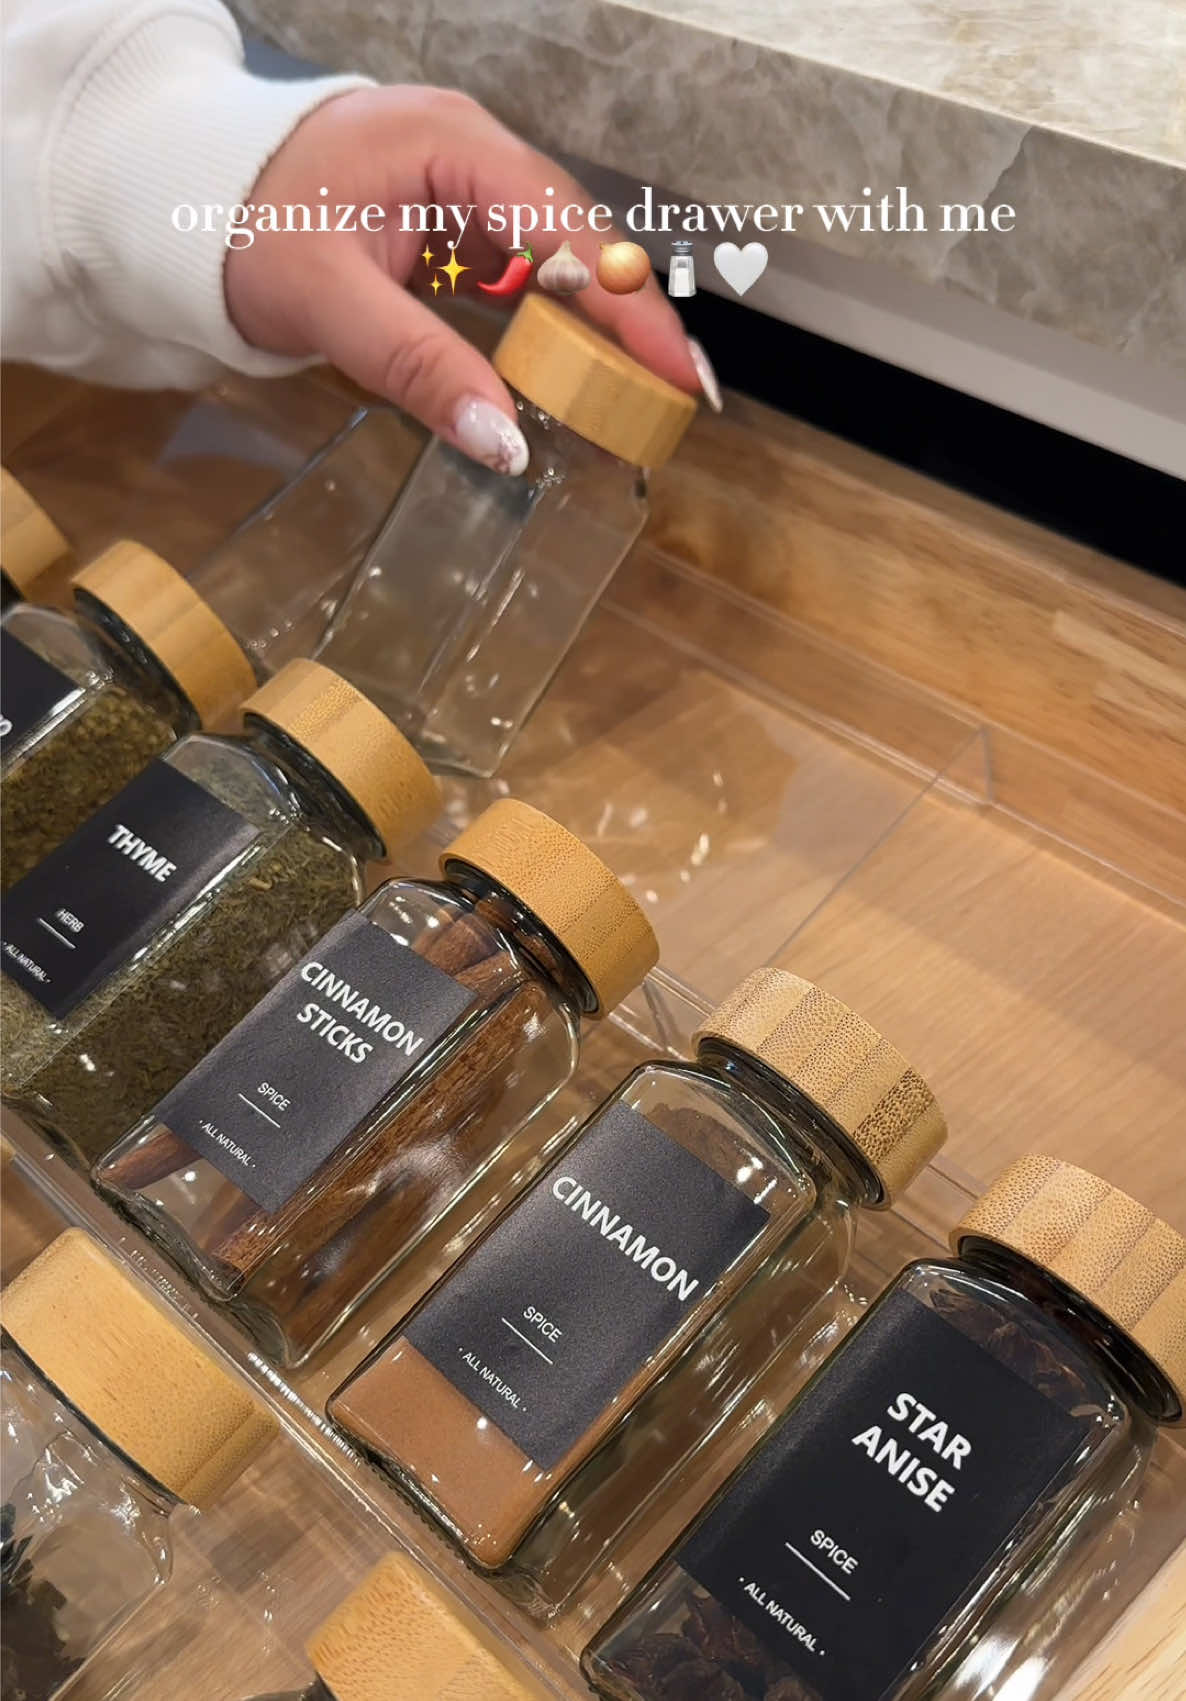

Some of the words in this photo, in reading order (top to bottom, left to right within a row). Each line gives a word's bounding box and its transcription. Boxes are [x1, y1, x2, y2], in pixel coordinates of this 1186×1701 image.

[107, 823, 177, 882] THYME
[56, 908, 85, 933] HERB
[5, 944, 20, 958] ALL
[17, 953, 48, 982] NATURAL
[296, 1003, 374, 1063] STICKS
[301, 961, 424, 1057] CINNAMON
[257, 1082, 291, 1111] SPICE
[202, 1122, 218, 1138] ALL
[216, 1133, 251, 1166] NATURAL
[552, 1176, 699, 1302] CINNAMON
[523, 1306, 562, 1343] SPICE
[462, 1352, 481, 1371] ALL
[479, 1366, 521, 1408] NATURAL
[887, 1392, 972, 1470] STAR
[851, 1425, 955, 1513] ANISE
[810, 1529, 859, 1574] SPICE
[744, 1582, 766, 1606] ALL
[765, 1600, 818, 1652] NATURAL
